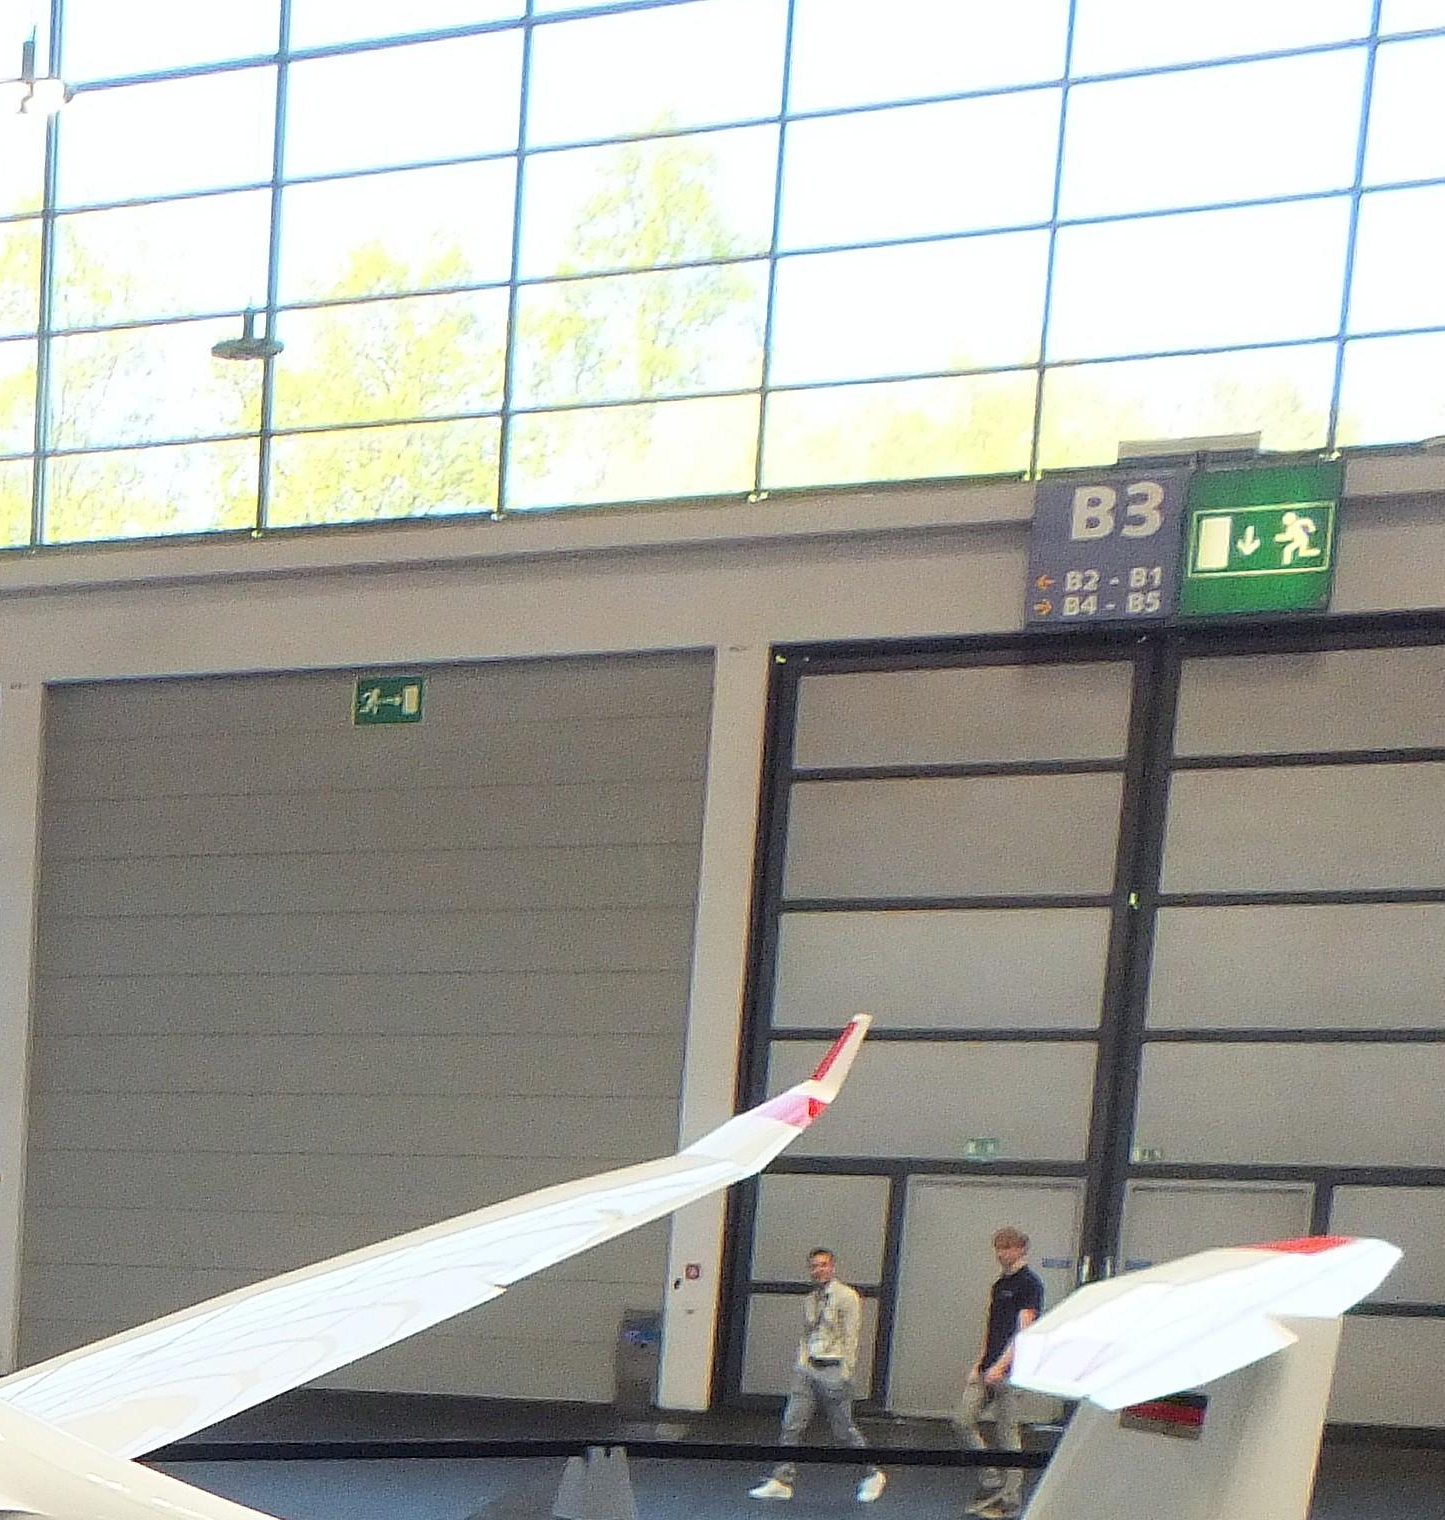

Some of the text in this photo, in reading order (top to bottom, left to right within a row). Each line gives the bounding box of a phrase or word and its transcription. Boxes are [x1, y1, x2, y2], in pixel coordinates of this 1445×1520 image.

[1069, 481, 1165, 541] B3
[1065, 569, 1100, 592] B2
[1130, 566, 1163, 588] B1
[1062, 594, 1098, 616] B4
[1126, 590, 1161, 613] B5
